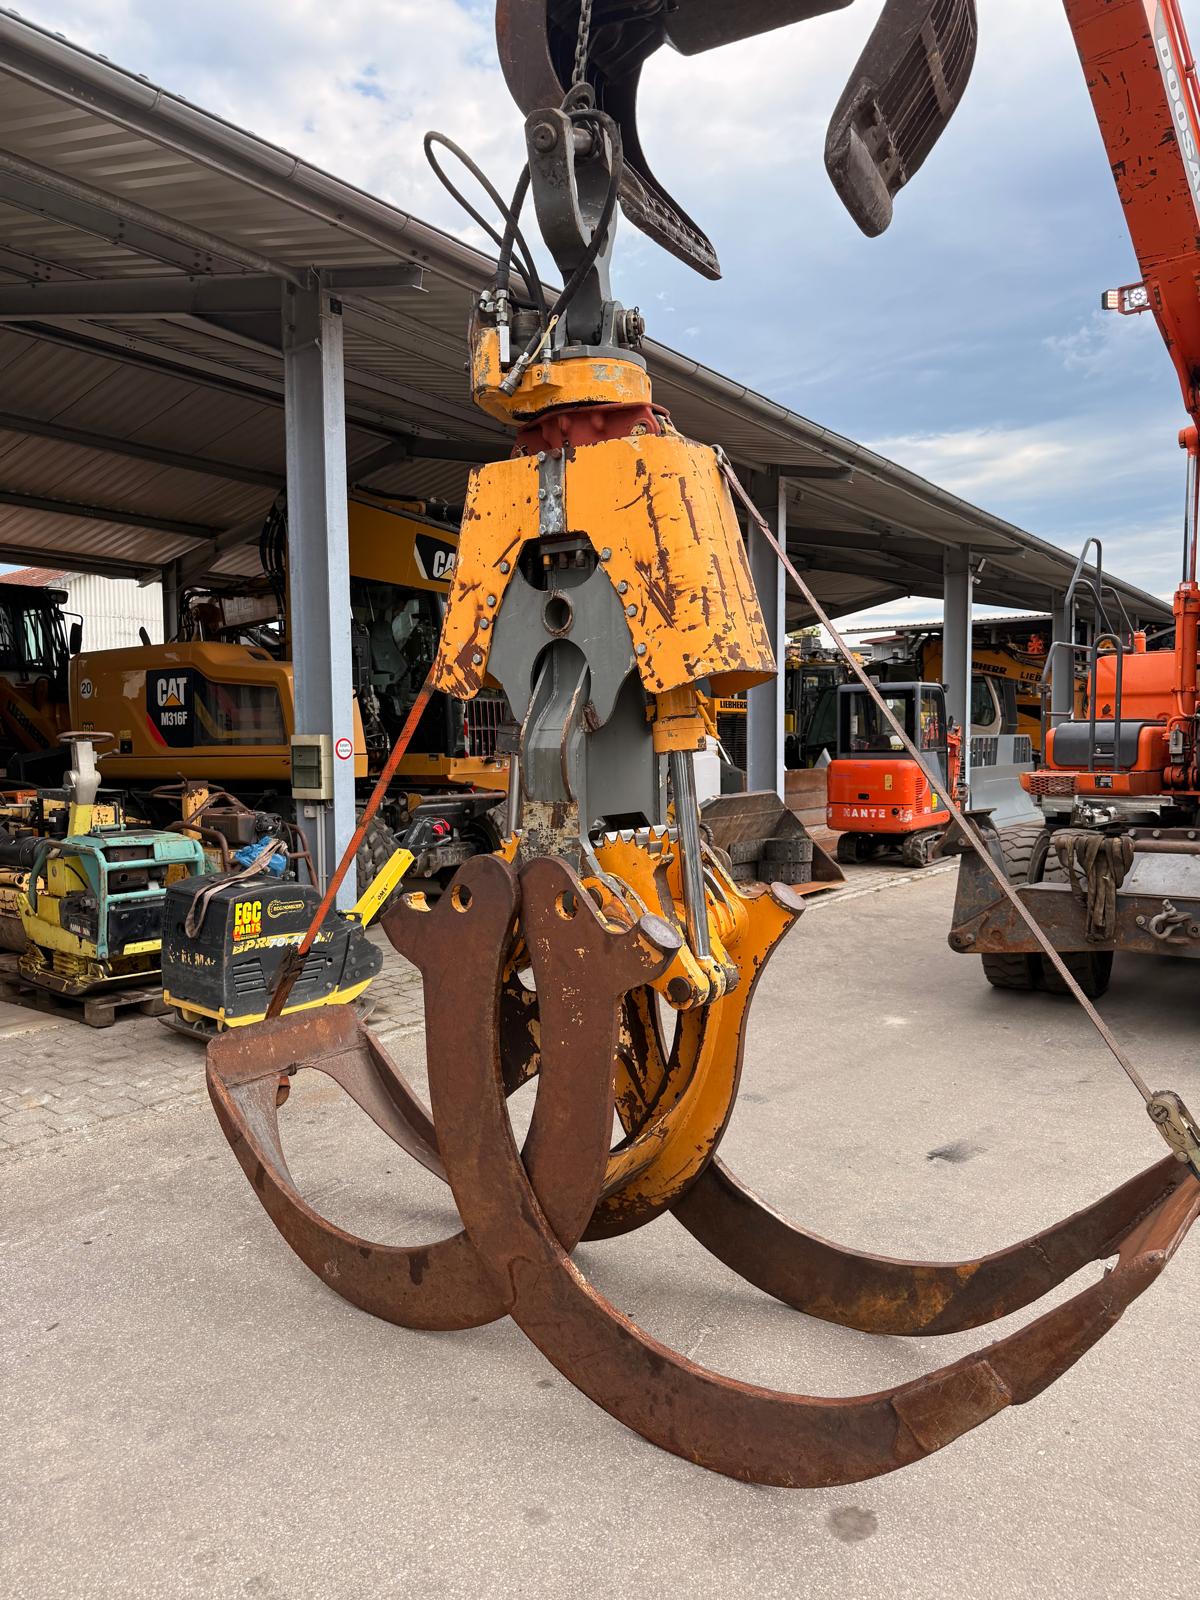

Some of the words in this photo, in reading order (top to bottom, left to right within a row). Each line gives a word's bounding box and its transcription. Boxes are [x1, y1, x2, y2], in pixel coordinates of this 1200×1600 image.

[432, 550, 456, 578] CA
[1020, 671, 1042, 682] LIEB
[81, 682, 91, 694] 20
[157, 677, 188, 706] CAT
[160, 711, 188, 726] M316F
[234, 922, 262, 935] PARTS
